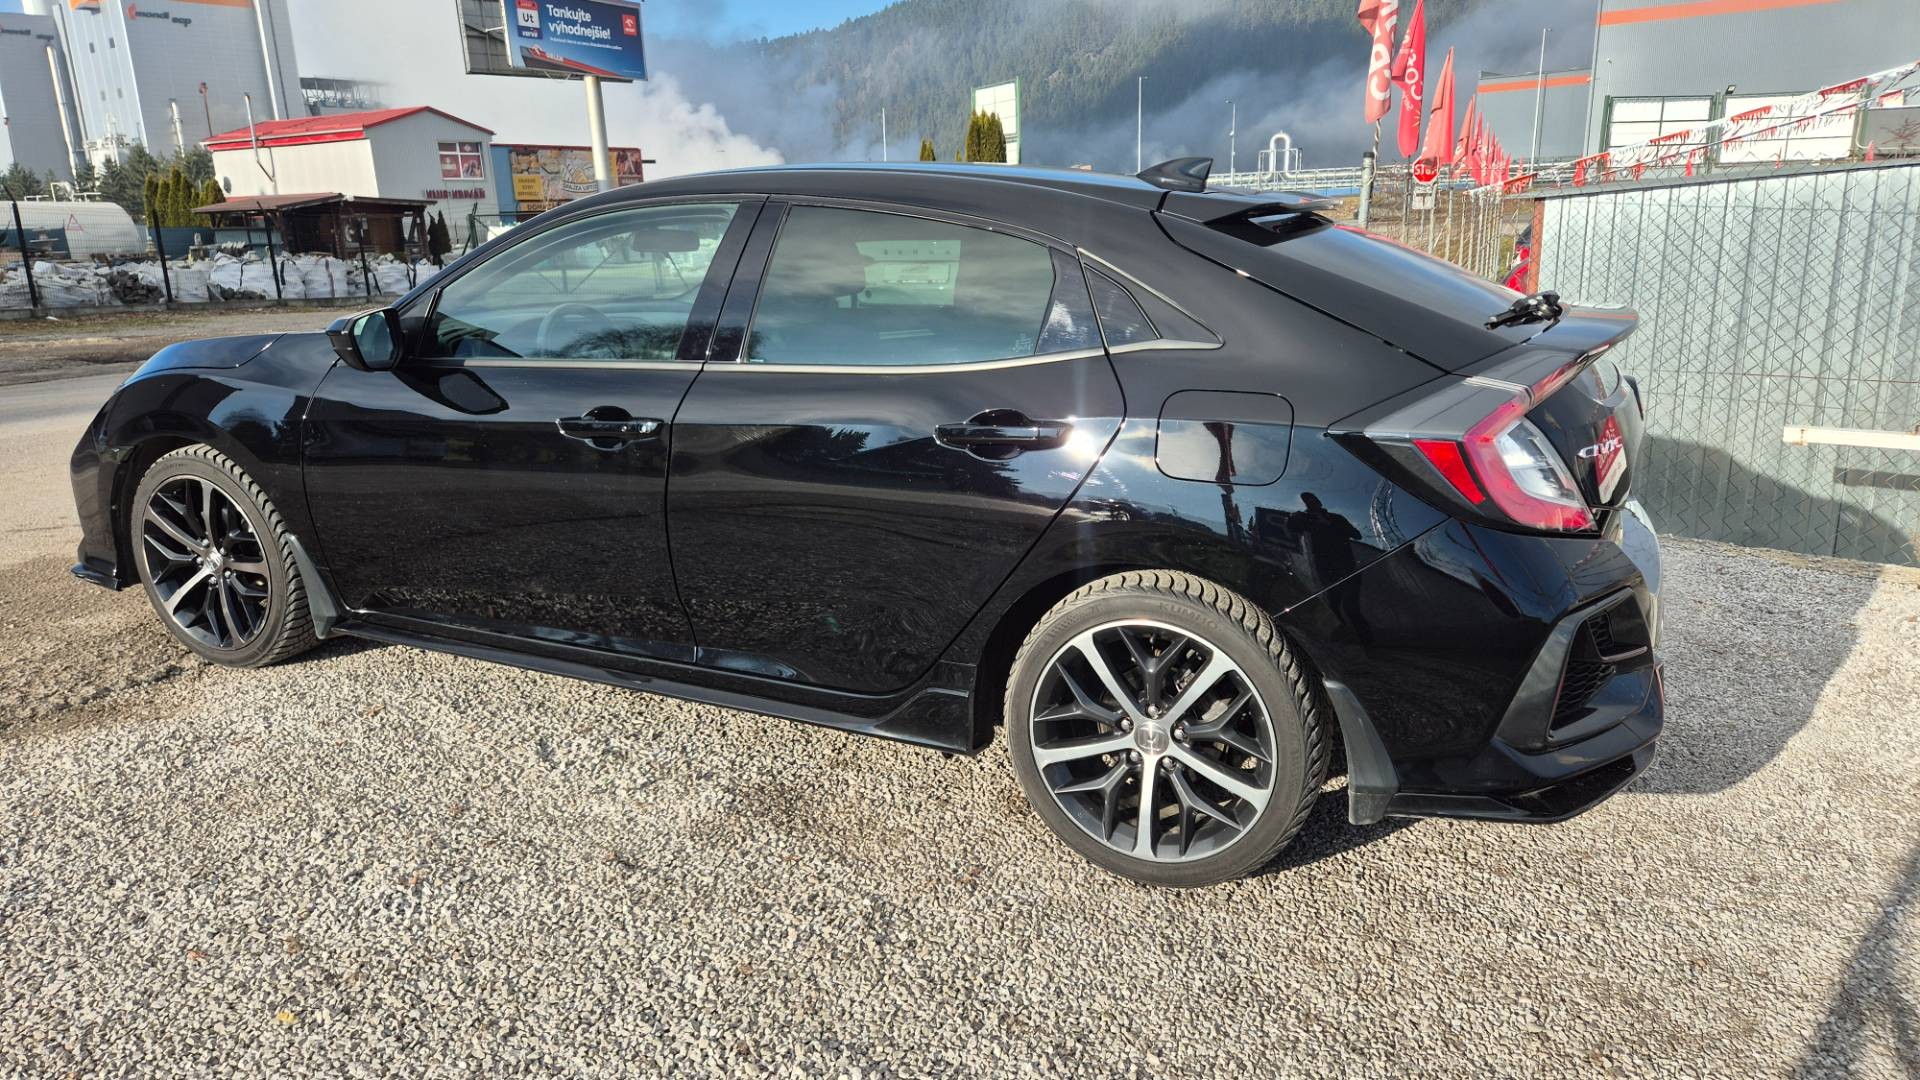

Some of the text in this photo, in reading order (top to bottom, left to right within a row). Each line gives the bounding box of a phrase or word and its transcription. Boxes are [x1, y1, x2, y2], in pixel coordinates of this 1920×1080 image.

[522, 12, 534, 23] Ut
[546, 4, 592, 23] Tankujte
[548, 21, 611, 41] výhodnejšie!
